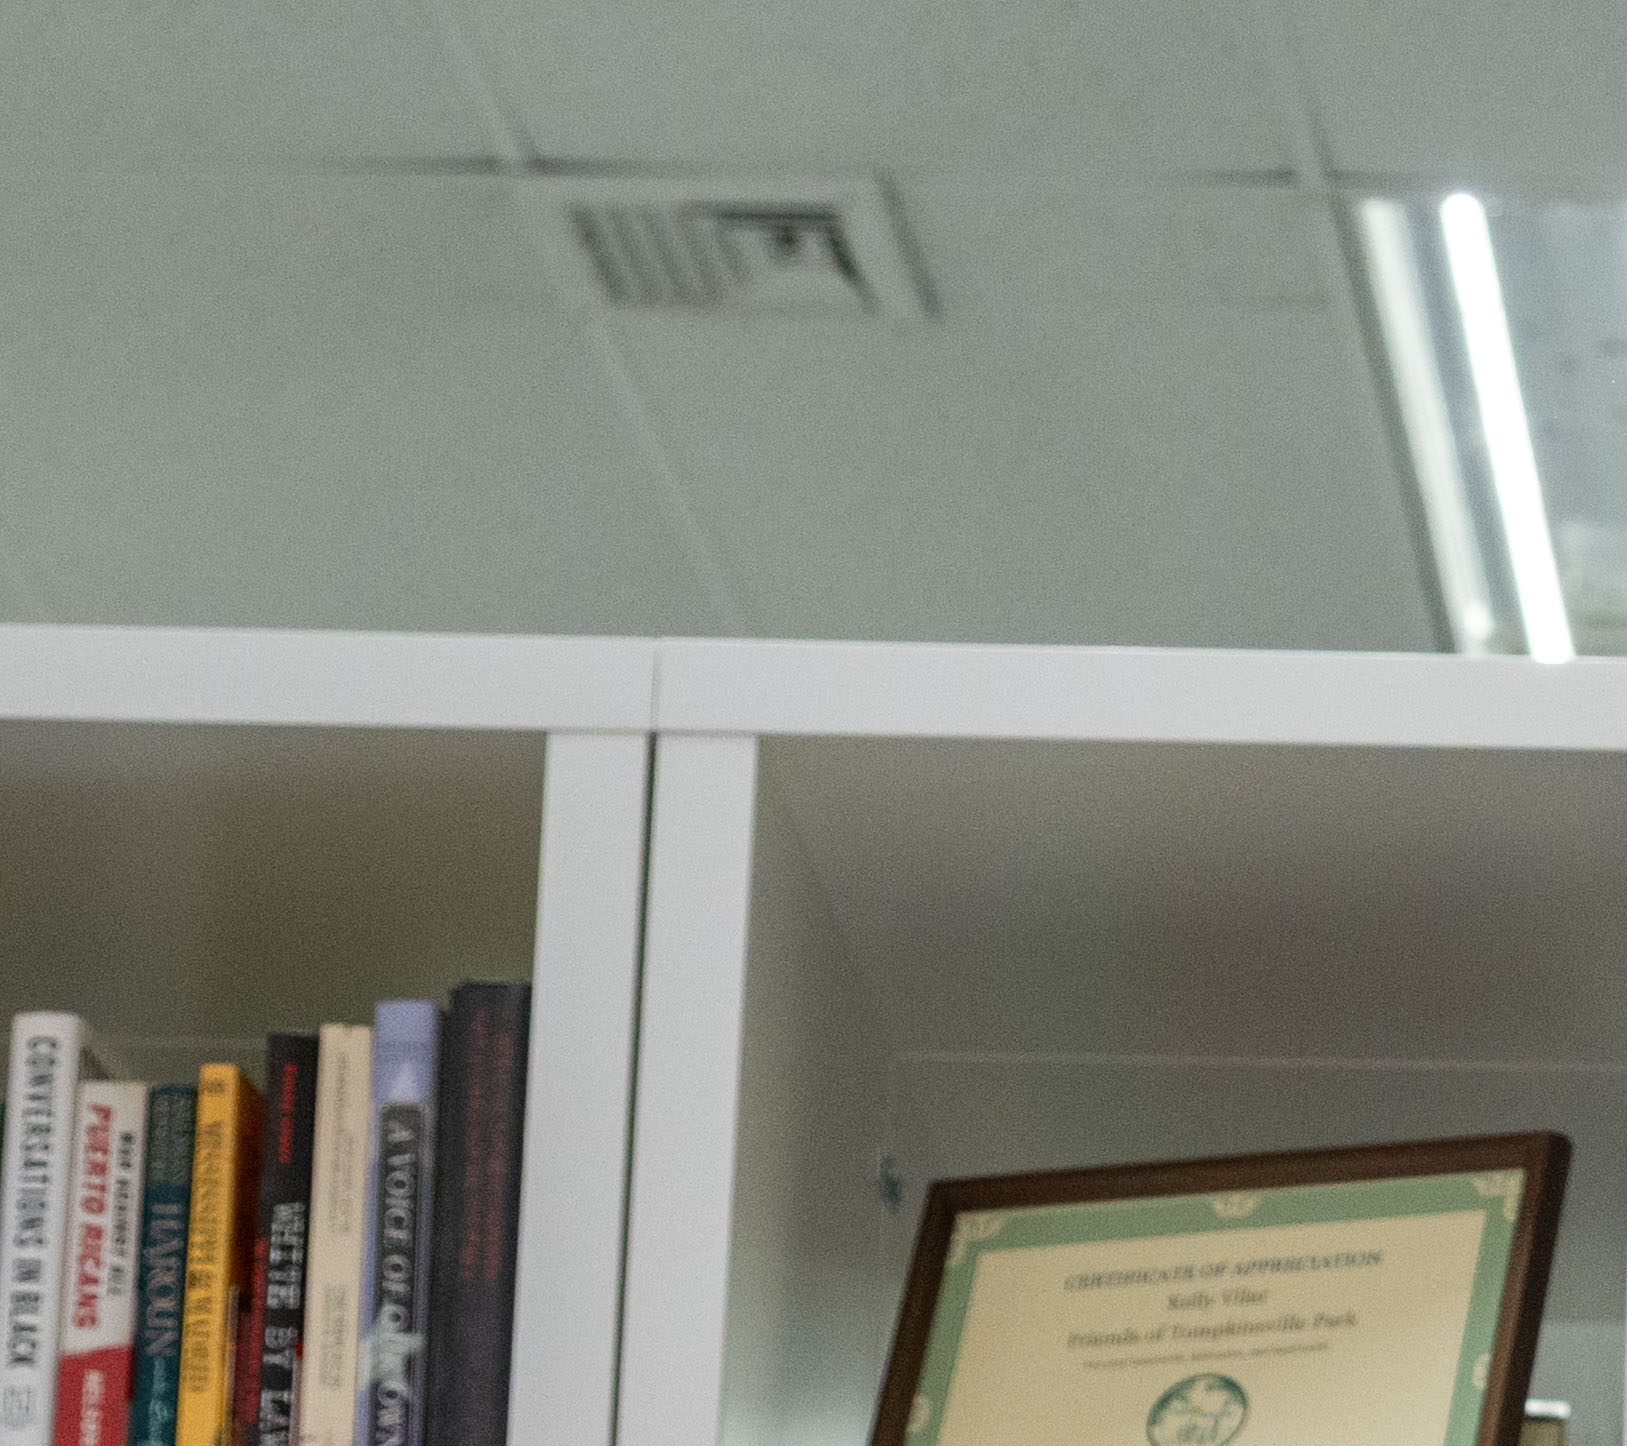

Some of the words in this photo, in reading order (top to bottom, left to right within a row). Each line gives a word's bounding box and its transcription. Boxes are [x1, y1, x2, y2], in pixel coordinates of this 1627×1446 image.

[15, 1036, 58, 1249] CONVERSATIONS
[84, 1104, 111, 1213] PUERTO
[115, 1132, 135, 1170] WAR
[387, 1120, 415, 1143] A
[110, 1179, 132, 1256] AGAINST
[193, 1120, 222, 1266] MISSISSIPPI
[383, 1153, 416, 1242] VOICE
[12, 1258, 42, 1282] IN
[76, 1223, 105, 1330] RICANS
[109, 1266, 127, 1297] ALL
[146, 1202, 182, 1357] HAROUN
[269, 1202, 305, 1309] WHITE
[381, 1253, 410, 1292] OF
[1064, 1265, 1194, 1292] CERTIFICATE
[1200, 1262, 1226, 1279] OF
[1234, 1250, 1383, 1275] APPRECIATION
[6, 1291, 42, 1369] BLACK
[262, 1326, 298, 1371] BY
